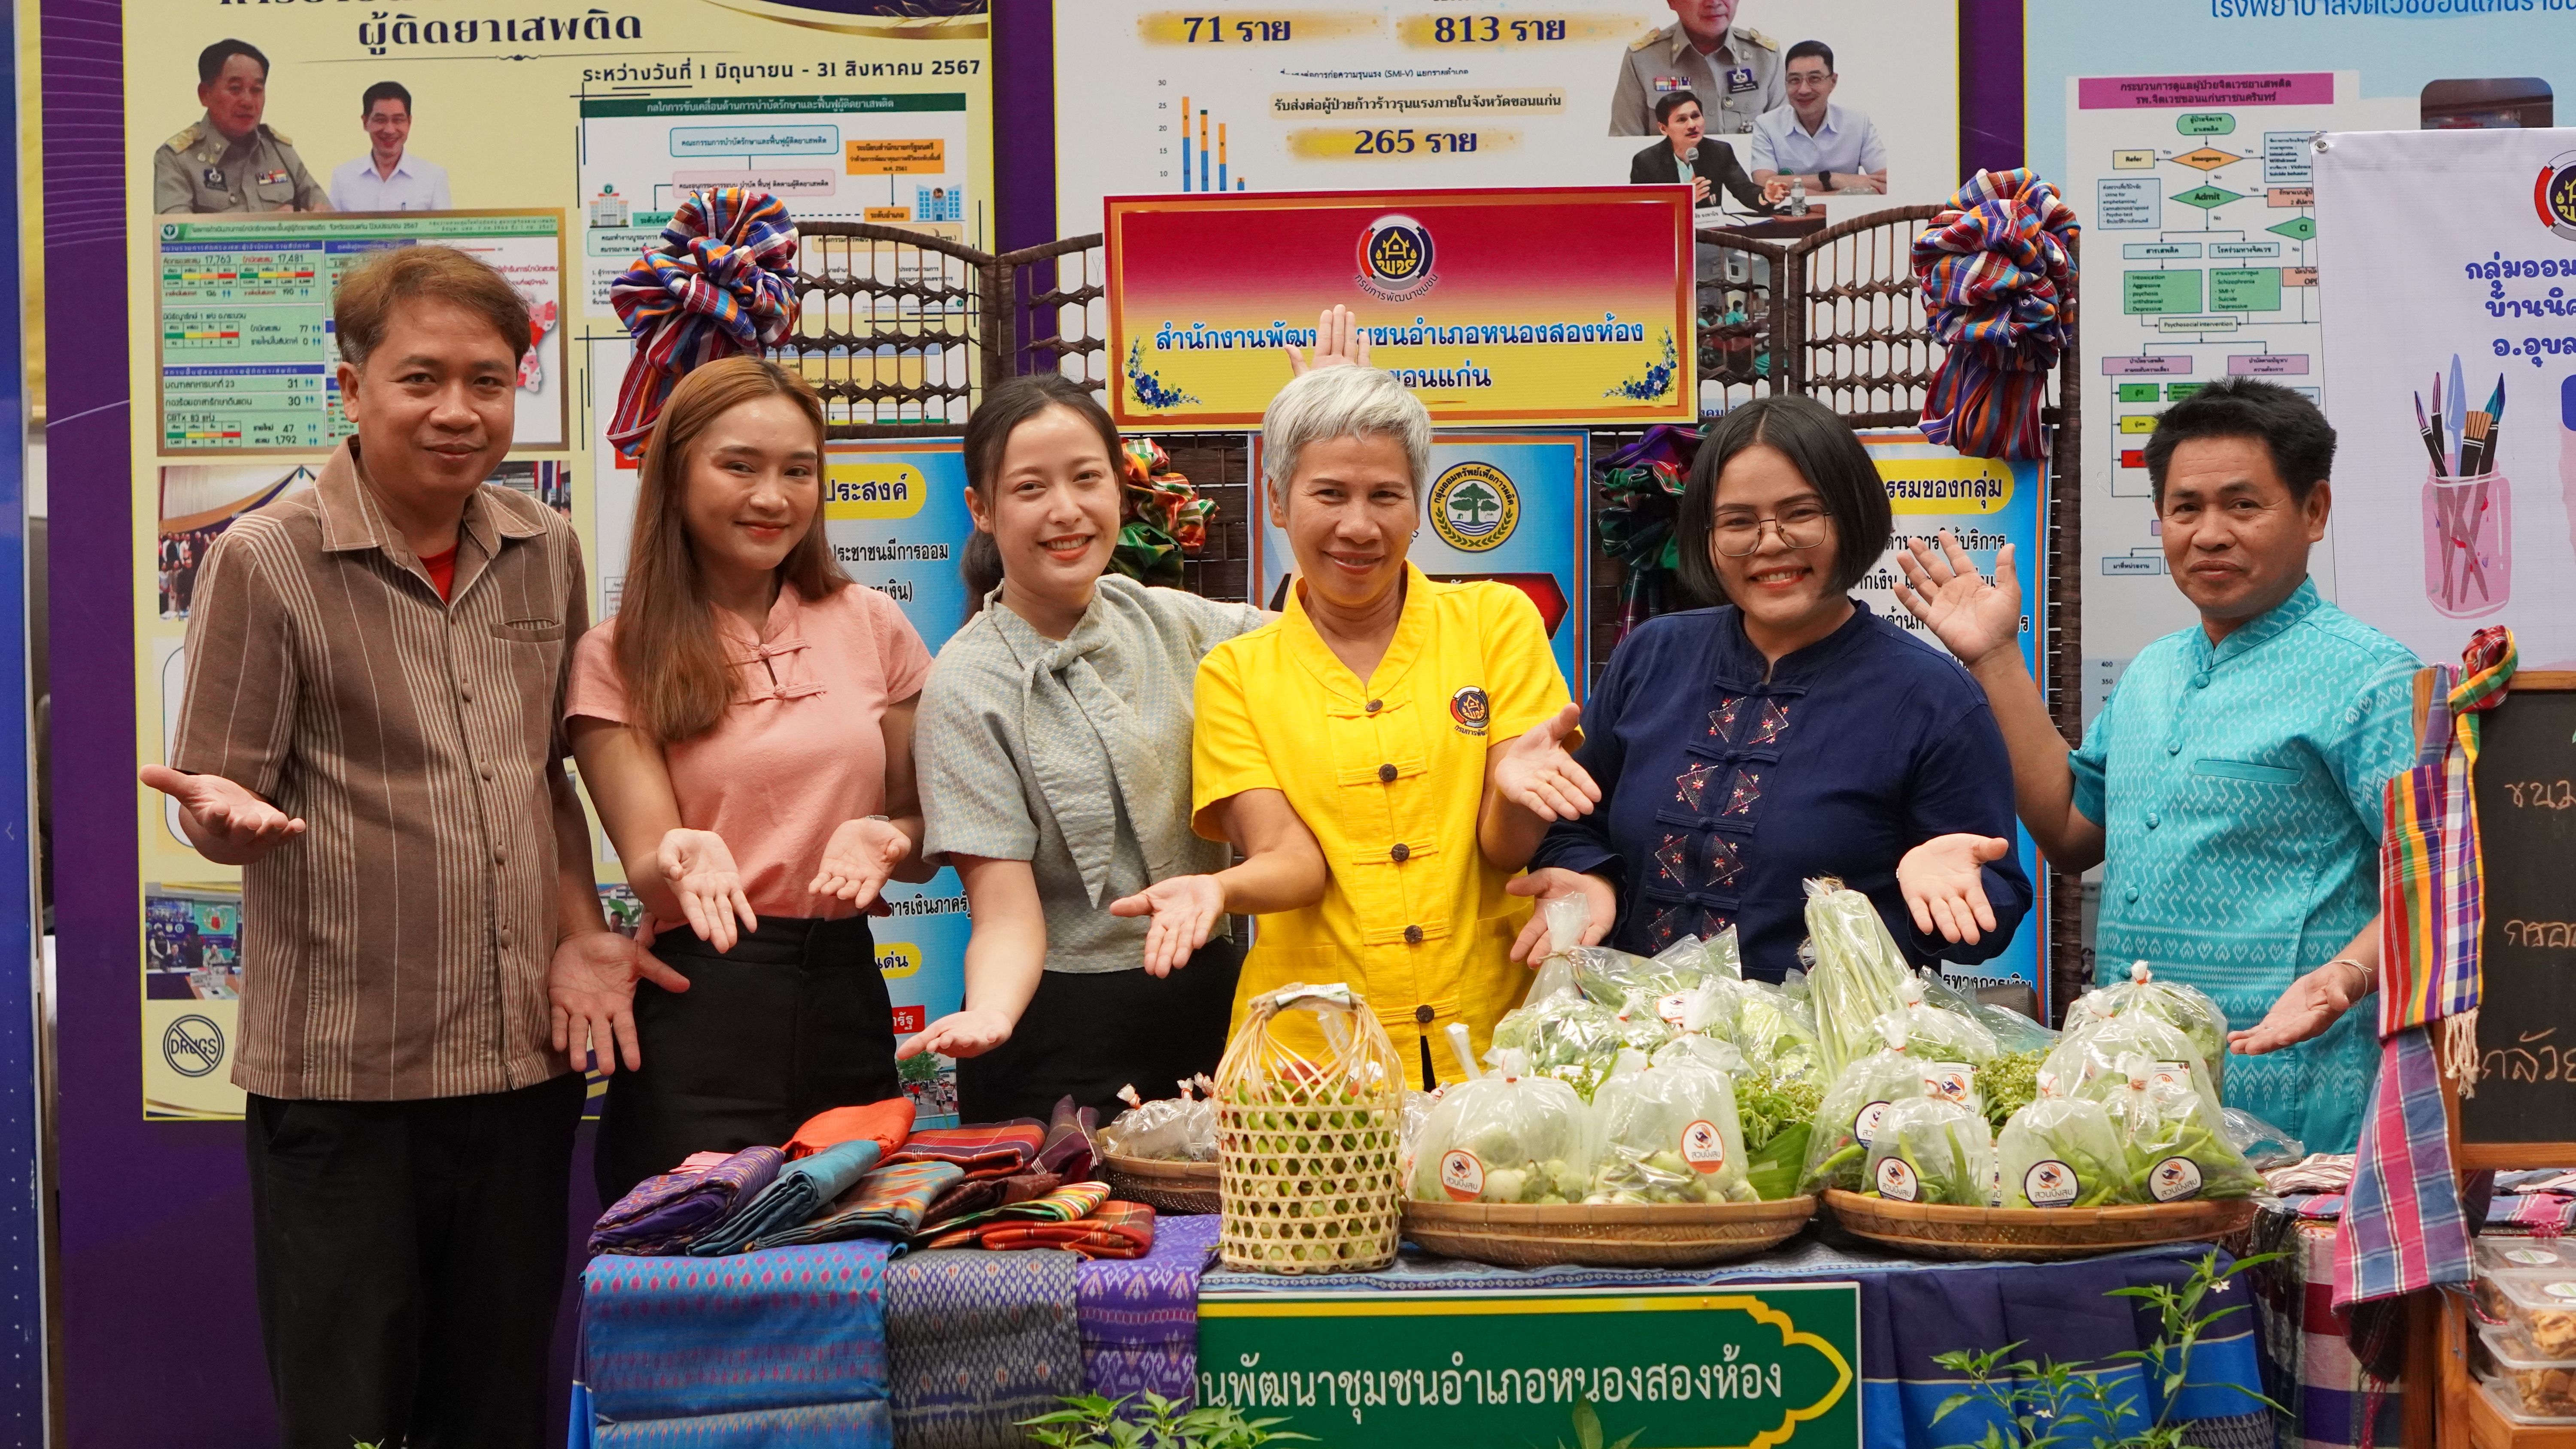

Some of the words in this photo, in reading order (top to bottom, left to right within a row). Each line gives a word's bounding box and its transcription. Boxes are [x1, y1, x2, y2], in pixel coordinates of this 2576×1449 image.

[359, 8, 644, 55] ผู้ติดยาเสพติด
[1183, 16, 1224, 43] 71
[1236, 19, 1291, 42] ราย
[1435, 15, 1500, 42] 813
[1510, 18, 1565, 42] ราย
[583, 57, 692, 82] ระหว่างวันที่
[700, 64, 706, 79] 1
[715, 61, 794, 84] มิถุนายน
[817, 63, 835, 77] 31
[844, 61, 923, 77] สิงหาคม
[931, 60, 981, 75] 2567
[1274, 94, 1562, 115] รับส่งต่อผู้ป่วยก้าวร้าวรุนแรงภายในจังหวัดขอนแก่น
[1354, 129, 1415, 154] 265
[1425, 133, 1477, 153] ราย
[2194, 192, 2220, 201] Admit
[1354, 273, 1439, 302] กรมการพัฒนาชุมชน
[834, 537, 949, 561] ระชาชนมีการออม
